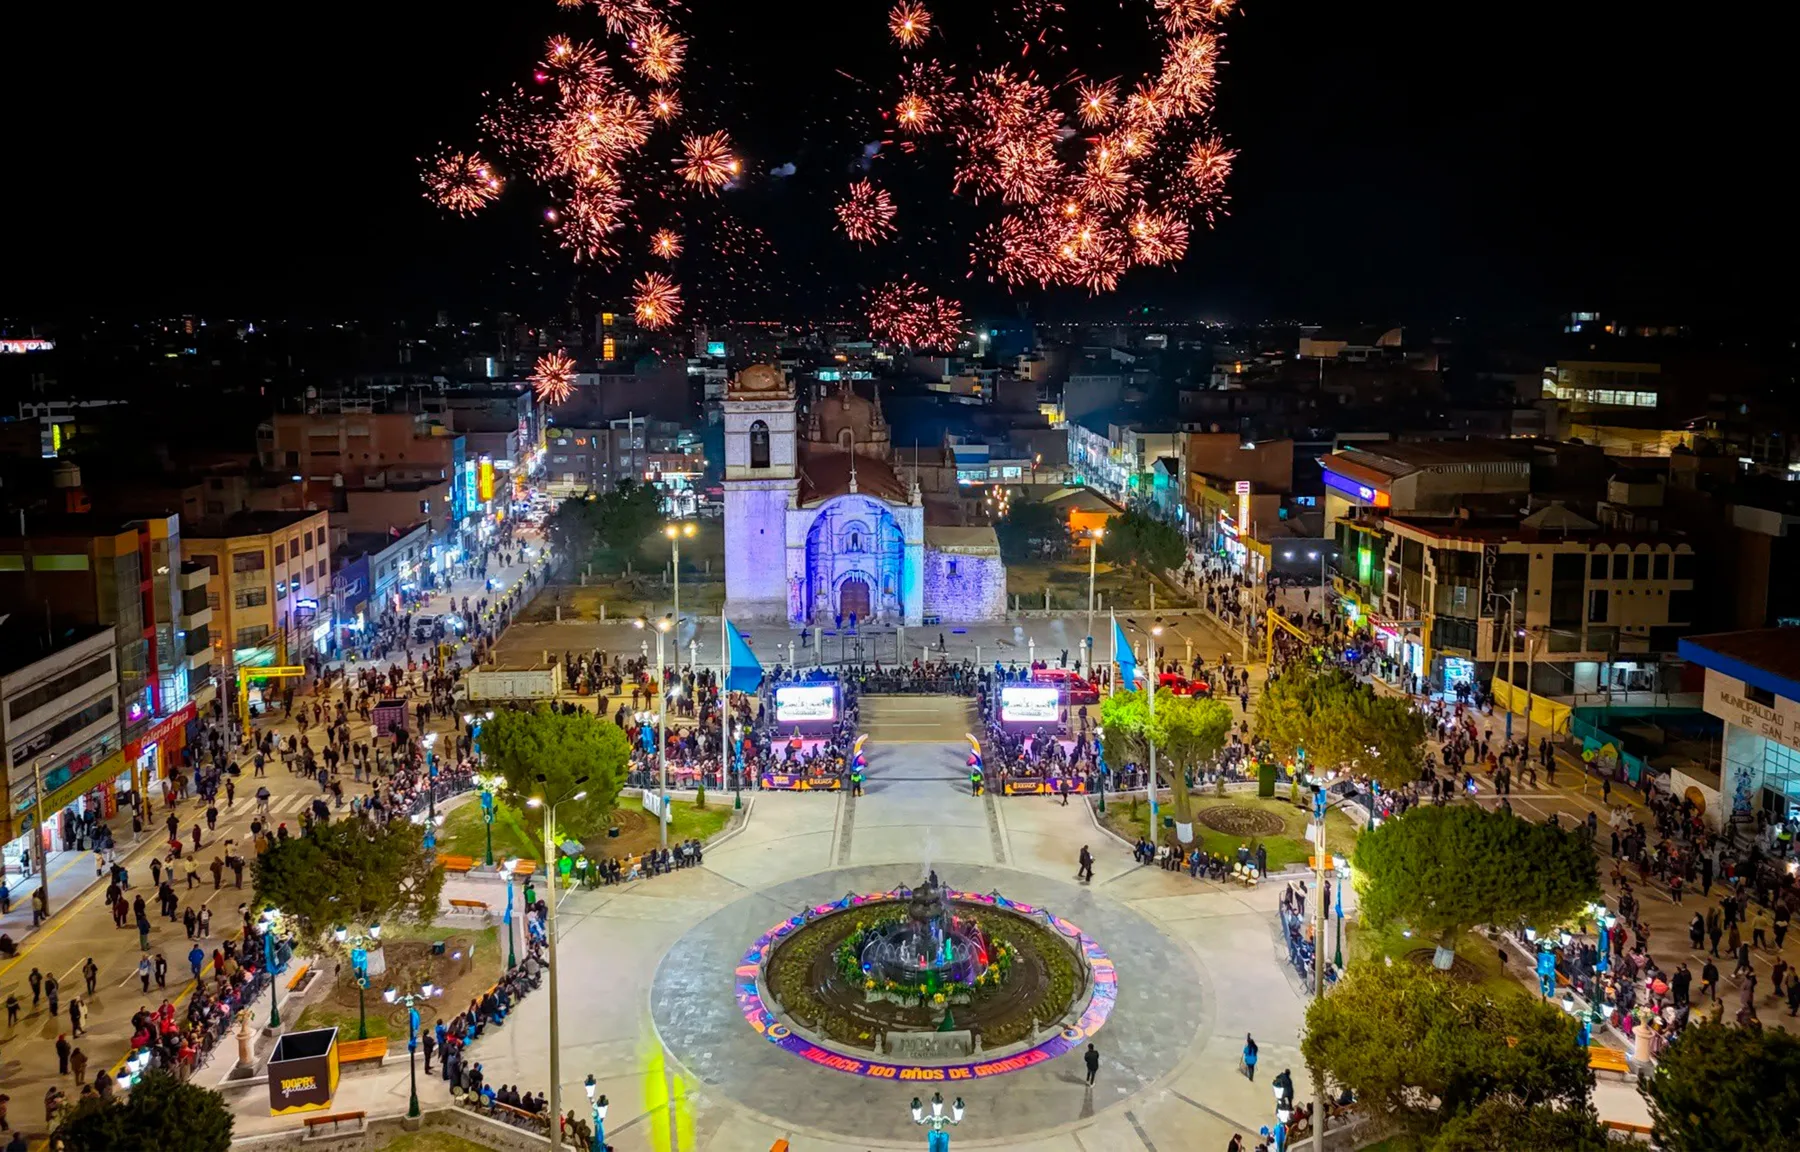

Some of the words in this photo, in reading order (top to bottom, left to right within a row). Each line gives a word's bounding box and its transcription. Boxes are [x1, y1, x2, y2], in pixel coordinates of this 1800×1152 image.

[1483, 545, 1497, 613] NOTARIA
[1720, 691, 1784, 726] MUNICIPALIDAD
[1741, 714, 1754, 728] DE
[799, 1047, 864, 1073] JULIACA:
[866, 1064, 896, 1078] 100
[899, 1067, 945, 1080] AÑOS
[948, 1067, 972, 1079] DE
[973, 1050, 1050, 1077] GRANDEZA
